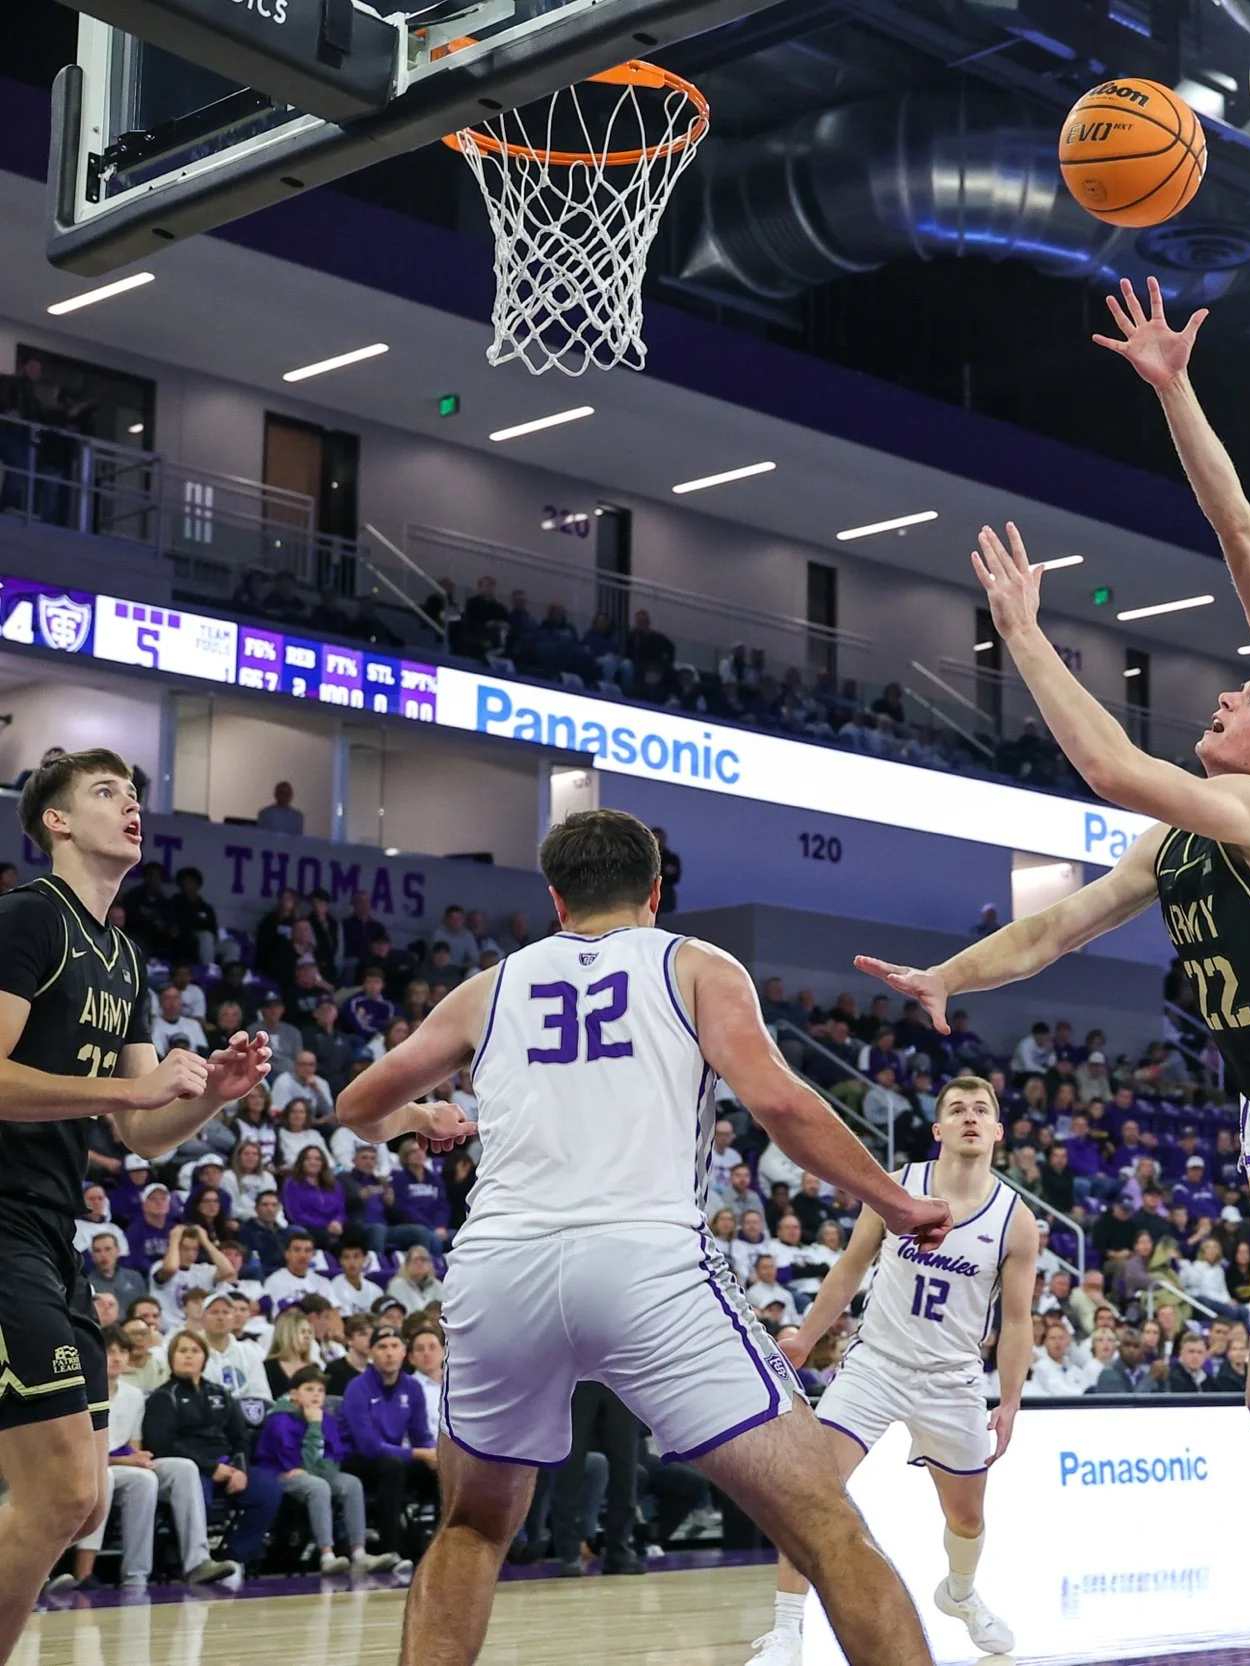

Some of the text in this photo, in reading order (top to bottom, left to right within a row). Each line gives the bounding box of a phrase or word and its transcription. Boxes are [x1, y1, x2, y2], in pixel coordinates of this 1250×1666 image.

[476, 684, 741, 784] Panasonic
[798, 832, 842, 864] 120
[225, 845, 426, 918] THOMAS
[1165, 895, 1219, 936] RMY
[79, 986, 132, 1038] ARMY
[527, 970, 634, 1066] 32
[898, 1235, 980, 1277] Tommies
[911, 1273, 951, 1323] 12
[1059, 1447, 1208, 1487] Panasonic
